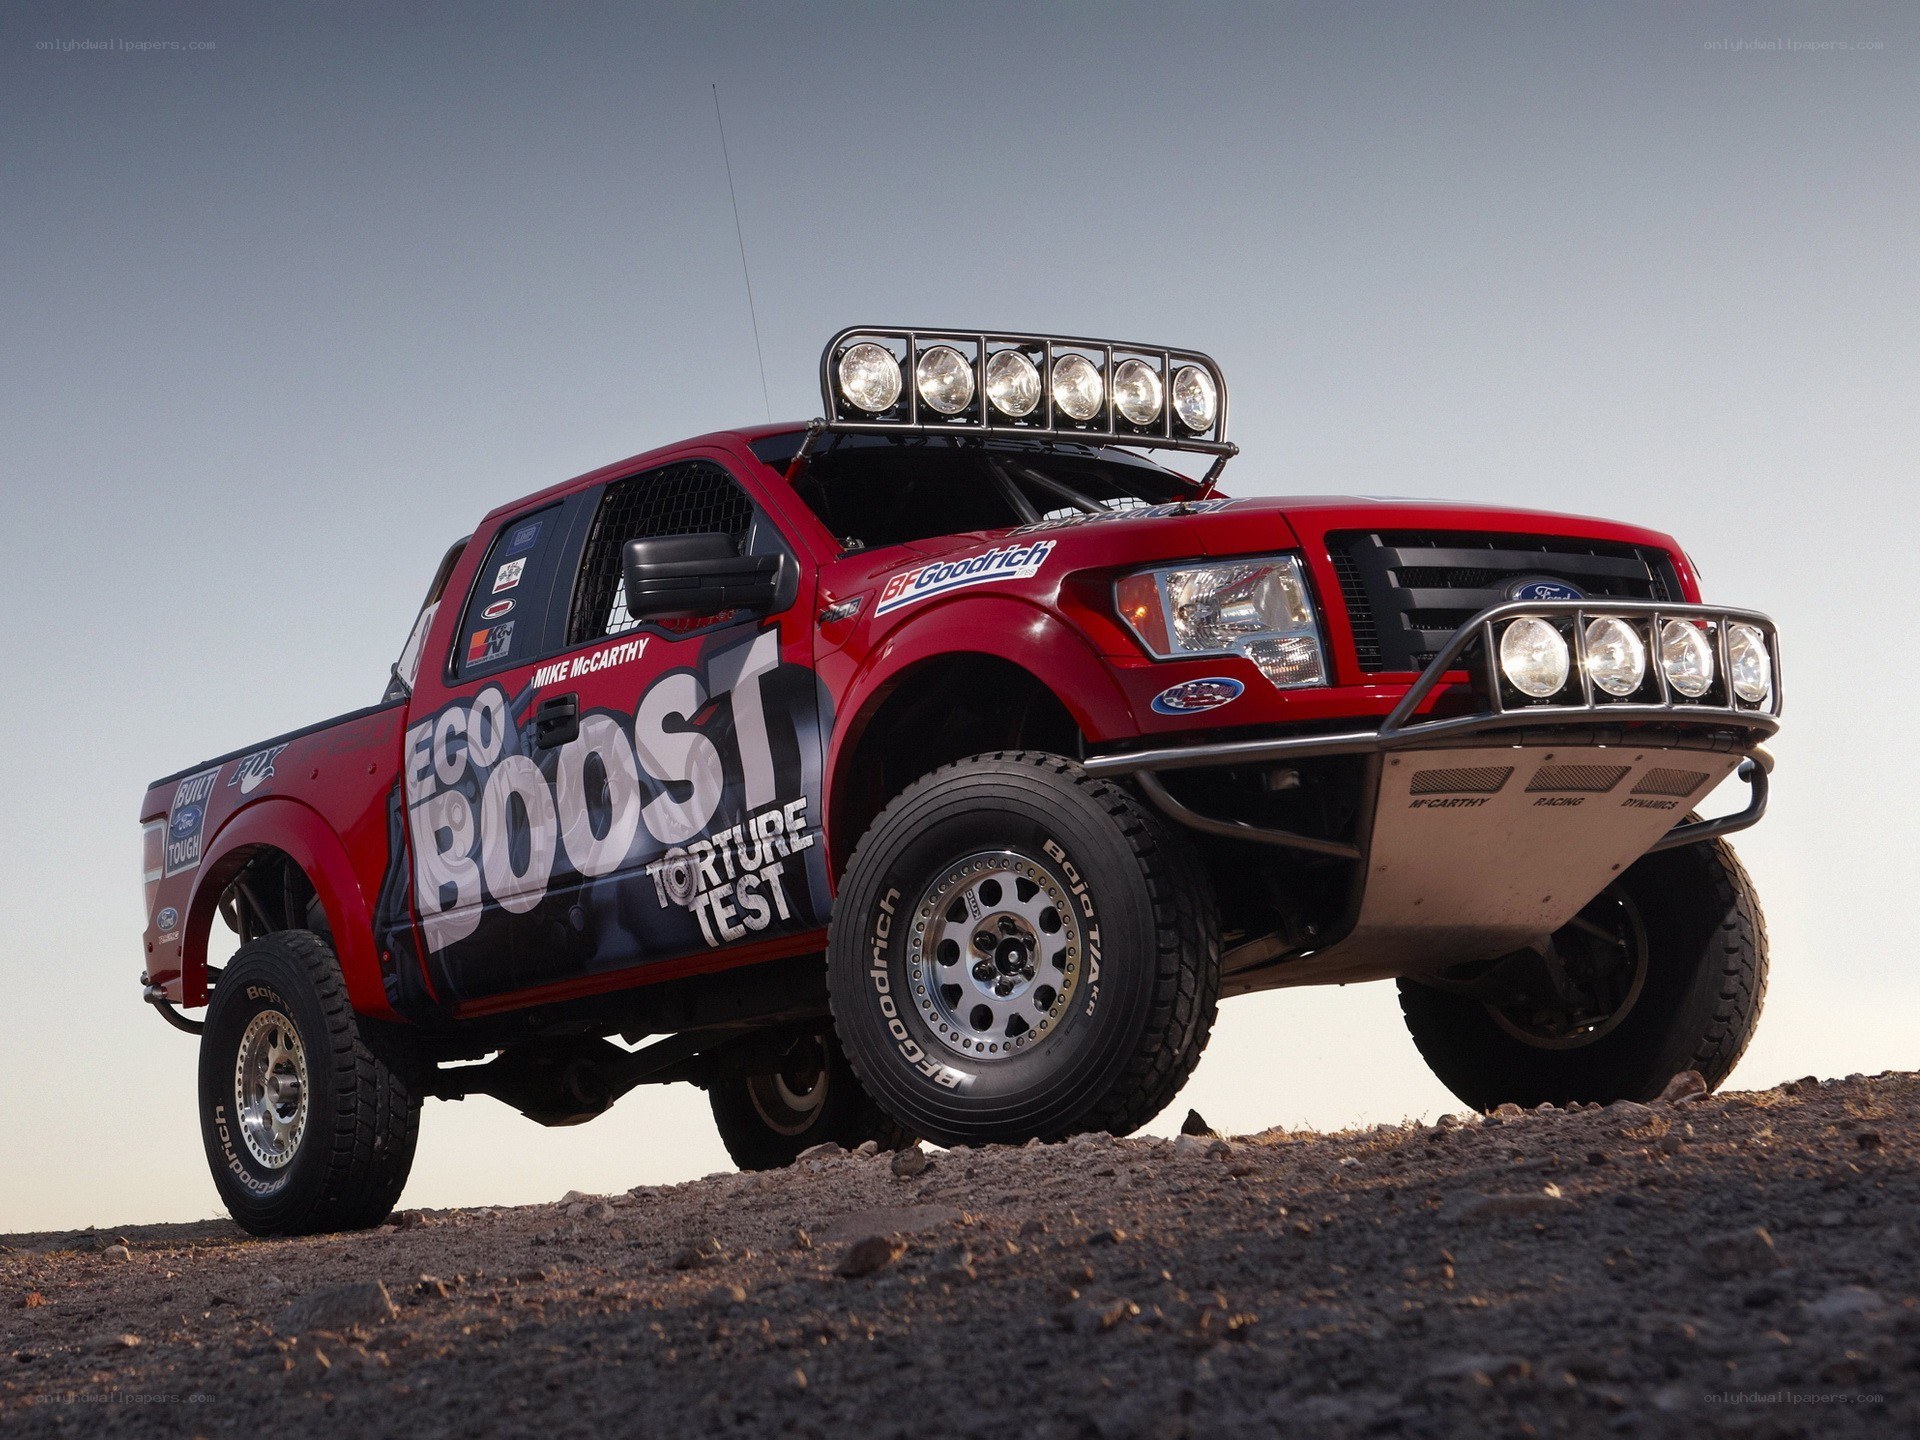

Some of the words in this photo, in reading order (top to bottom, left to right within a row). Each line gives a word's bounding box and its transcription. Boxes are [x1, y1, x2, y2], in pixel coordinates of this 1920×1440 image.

[881, 543, 1048, 600] BFGoodrich
[534, 661, 570, 688] MIKE
[570, 638, 650, 678] McCARTHY
[405, 687, 506, 804] ECO
[175, 773, 217, 809] BUILT
[409, 629, 780, 954] BOOST
[1408, 798, 1491, 809] McCARTHY
[1533, 798, 1585, 806] RACING
[1621, 798, 1679, 810] DYNAMICS
[169, 834, 200, 866] TOUGH
[645, 797, 814, 908] TORTURE
[1042, 838, 1095, 918] Baja
[688, 862, 791, 947] TEST
[870, 887, 978, 1089] BFGoodrich
